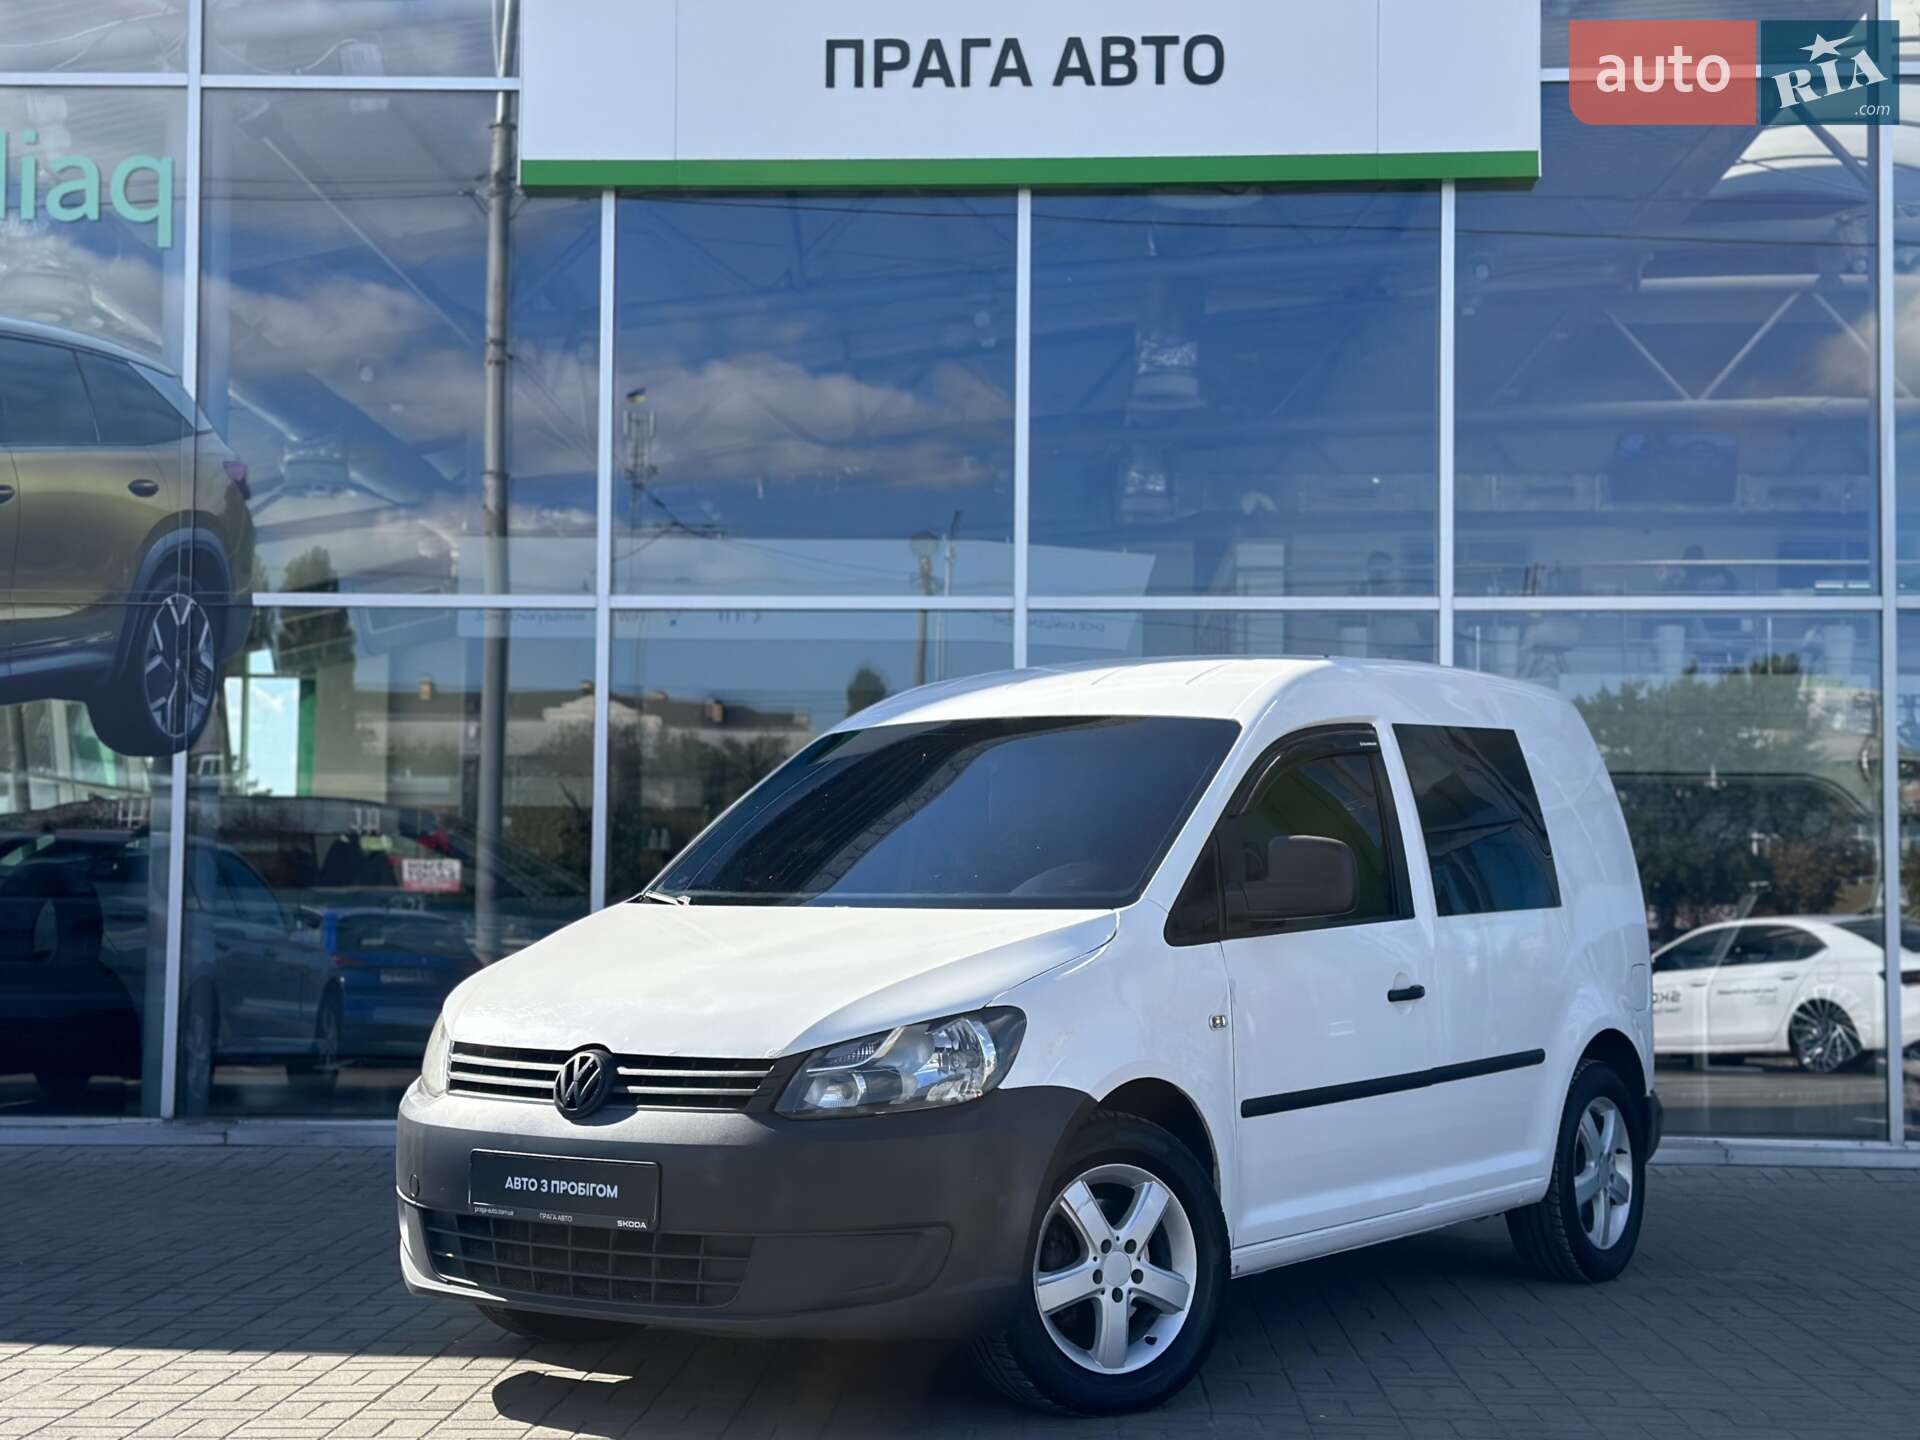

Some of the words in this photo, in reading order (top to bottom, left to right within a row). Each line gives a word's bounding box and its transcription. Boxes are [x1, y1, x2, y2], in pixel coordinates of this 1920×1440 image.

[825, 38, 1033, 88] ПРАГА
[1052, 34, 1225, 86] АВТО
[0, 129, 174, 247] iaq
[504, 1175, 538, 1192] АВТО
[540, 1179, 549, 1193] З
[551, 1180, 618, 1198] ПРОБІГОМ
[617, 1219, 647, 1229] SKODA
